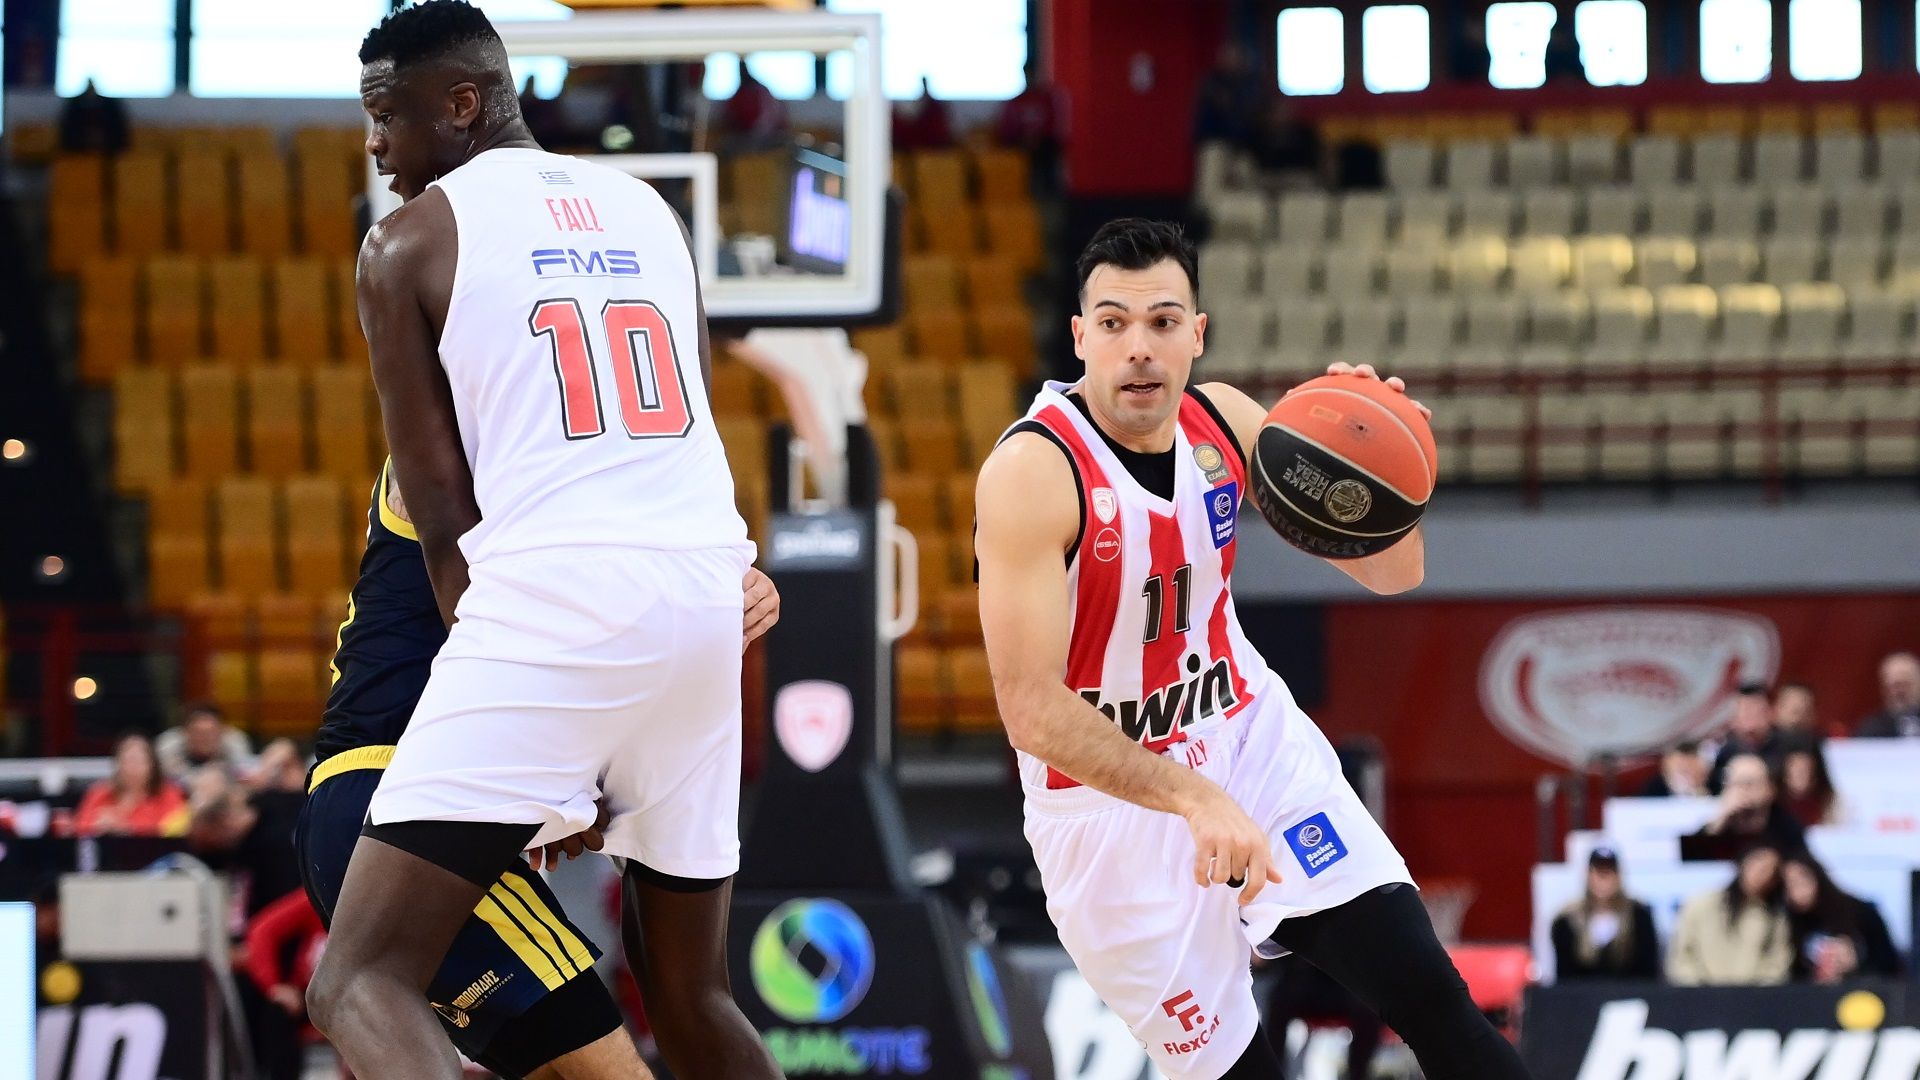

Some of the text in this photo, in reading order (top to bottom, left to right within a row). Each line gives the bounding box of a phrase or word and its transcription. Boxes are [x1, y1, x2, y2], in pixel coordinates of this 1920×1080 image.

[545, 197, 604, 232] FALL
[531, 249, 641, 276] FMS
[528, 297, 695, 441] 10
[1256, 483, 1372, 556] SPALDING
[1141, 563, 1191, 645] 11
[1185, 739, 1208, 770] ILY
[1306, 841, 1334, 862] Basket
[1310, 849, 1338, 869] League
[36, 961, 167, 1080] in
[1163, 1014, 1222, 1056] FlexCar
[764, 1026, 932, 1075] SMOTE
